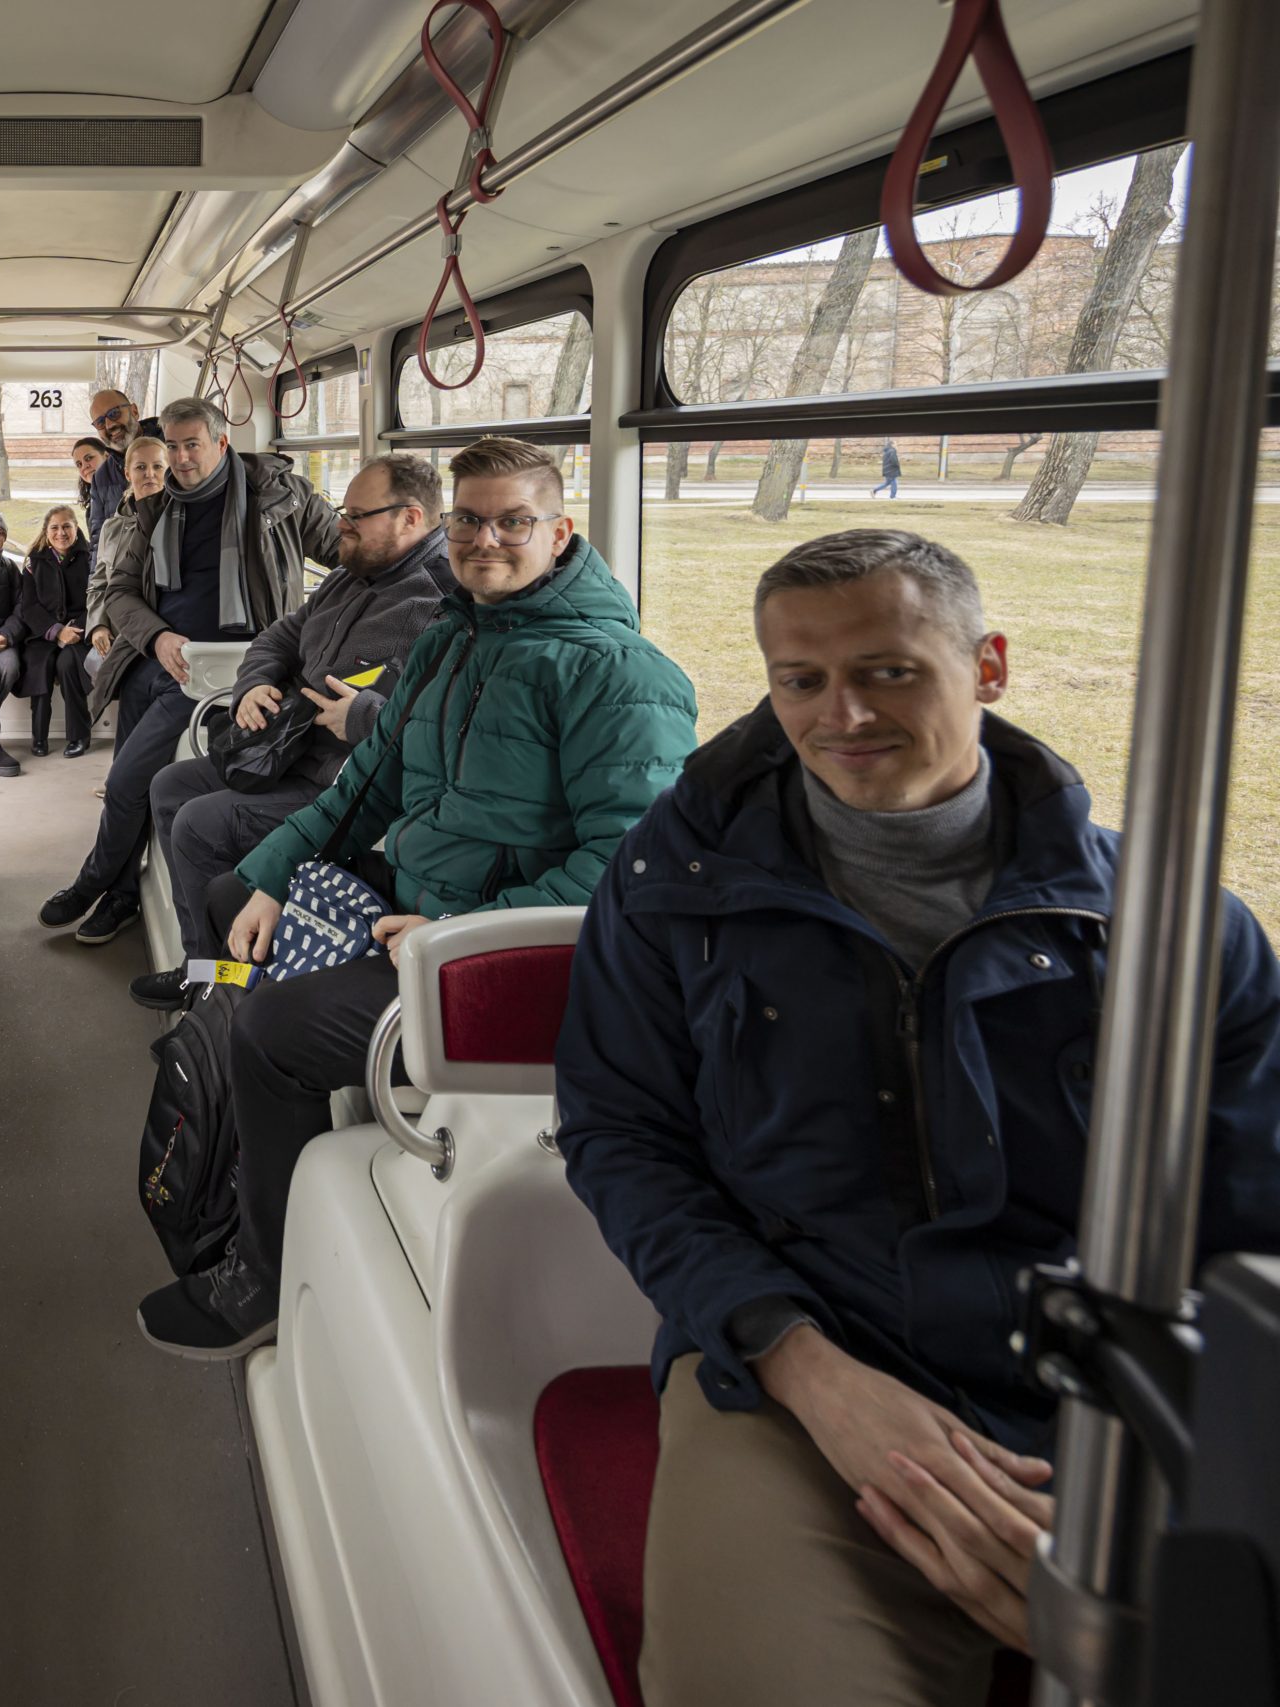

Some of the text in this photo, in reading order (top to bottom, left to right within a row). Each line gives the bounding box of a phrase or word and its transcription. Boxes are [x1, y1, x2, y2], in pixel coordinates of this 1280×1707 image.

[30, 390, 62, 408] 263
[293, 908, 339, 938] POLICE BOX
